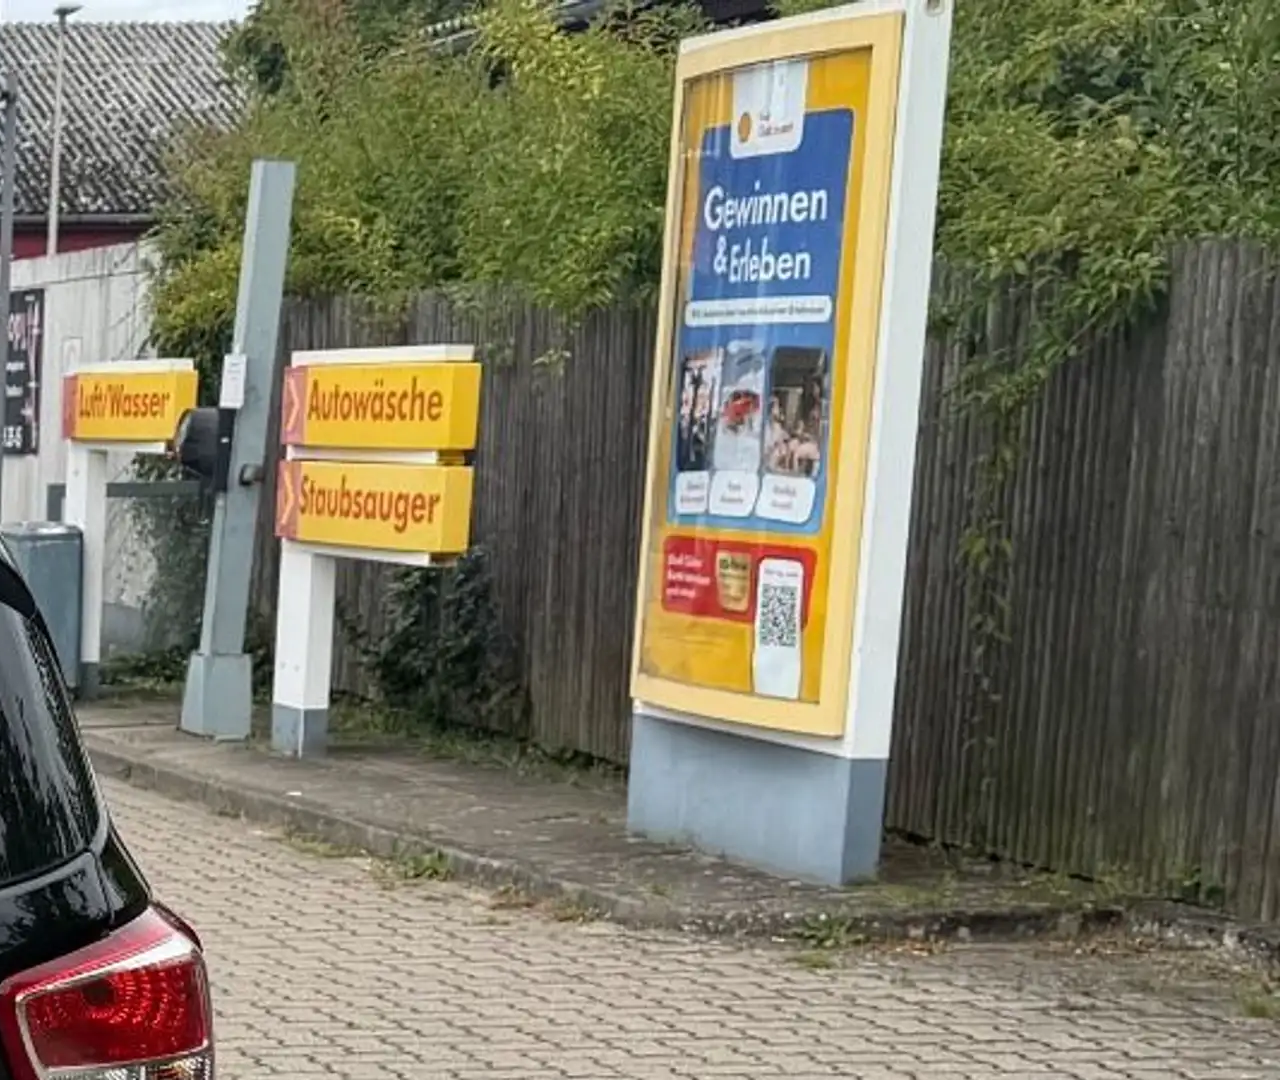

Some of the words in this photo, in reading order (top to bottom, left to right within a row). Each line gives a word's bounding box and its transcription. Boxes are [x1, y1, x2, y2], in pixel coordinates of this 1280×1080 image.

[703, 179, 828, 231] Gewinnen
[79, 383, 171, 418] Luft/Wasser
[307, 375, 444, 422] Autowäsche
[299, 474, 441, 534] Staubsauger
